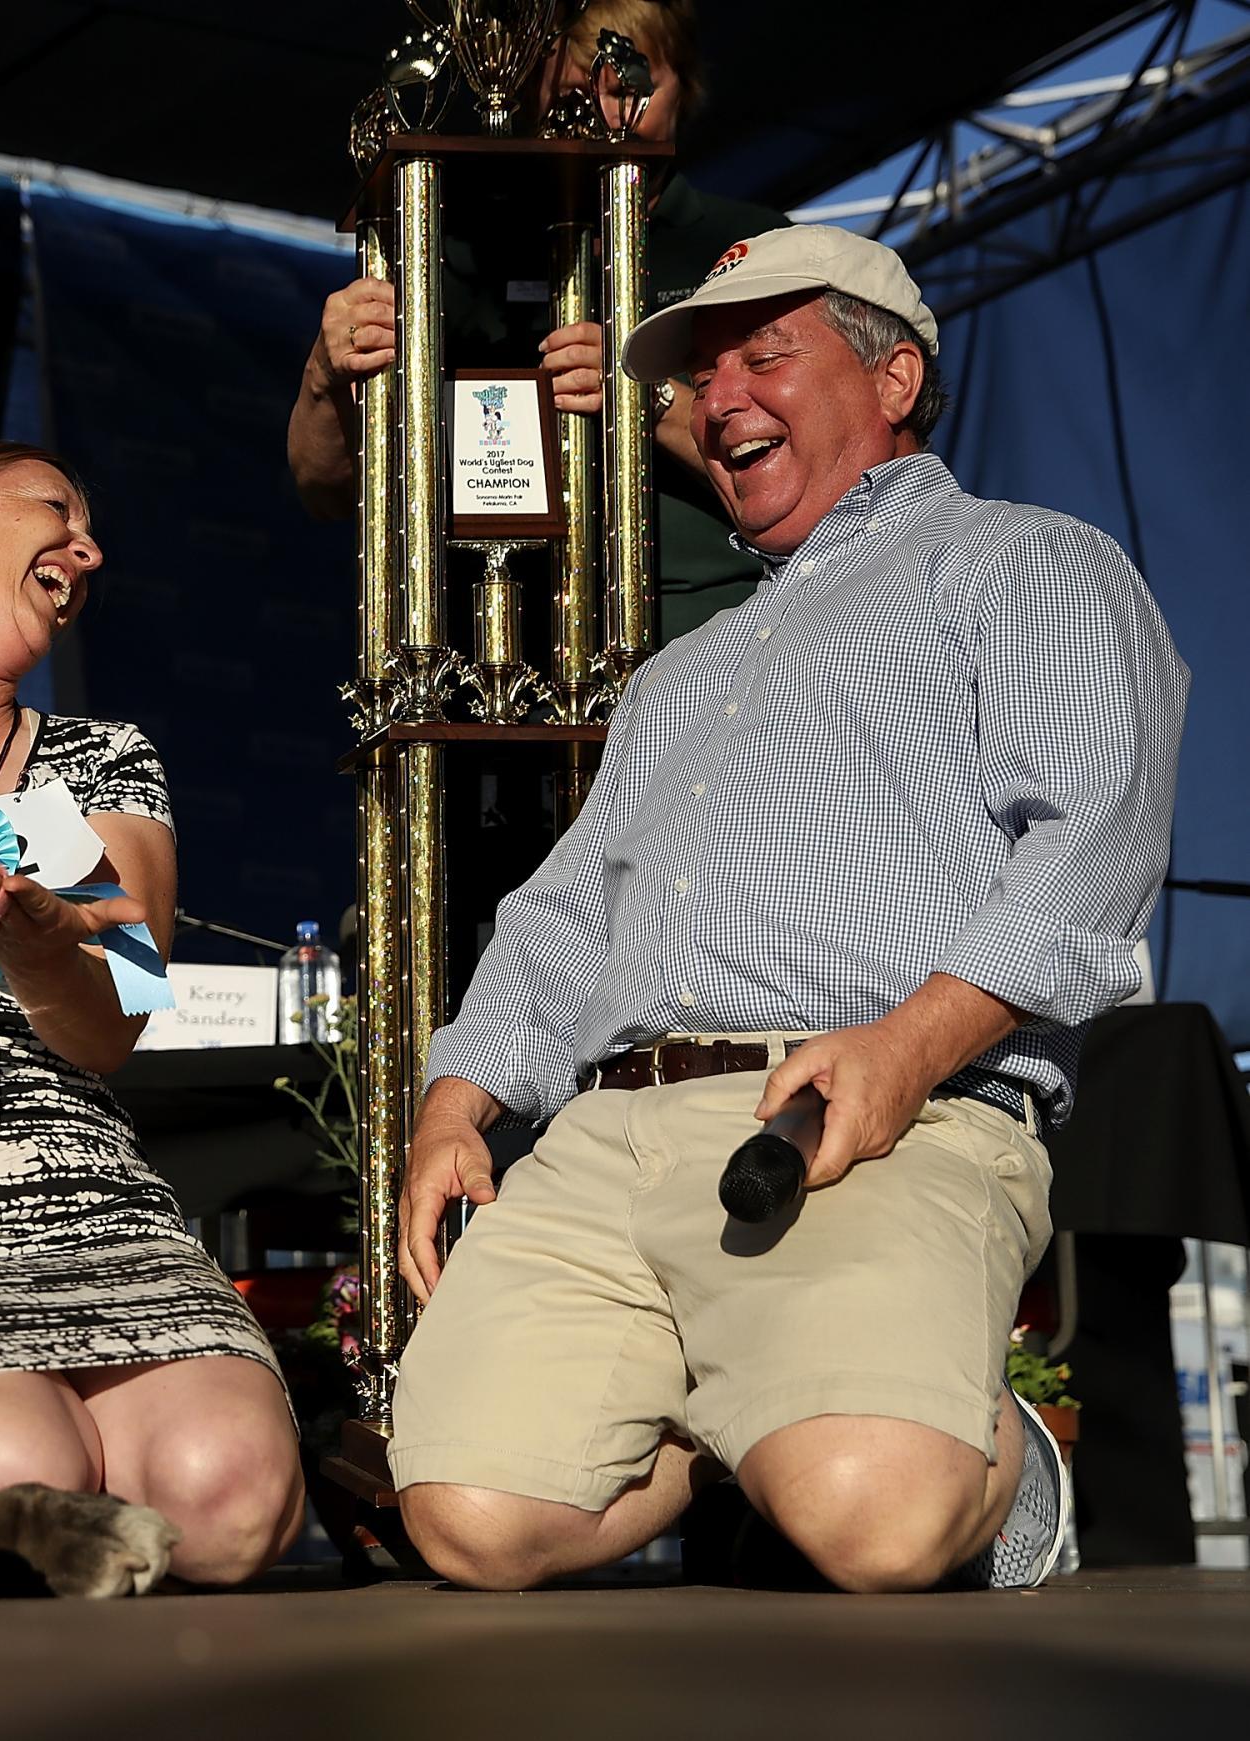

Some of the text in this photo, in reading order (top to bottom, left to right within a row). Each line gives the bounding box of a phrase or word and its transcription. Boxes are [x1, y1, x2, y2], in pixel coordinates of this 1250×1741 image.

[486, 450, 505, 458] 2017
[490, 459, 515, 467] Ugliest
[517, 459, 534, 467] Dog
[467, 478, 530, 488] CHAMPION
[190, 985, 247, 1006] Kerry
[176, 1008, 256, 1026] Sanders
